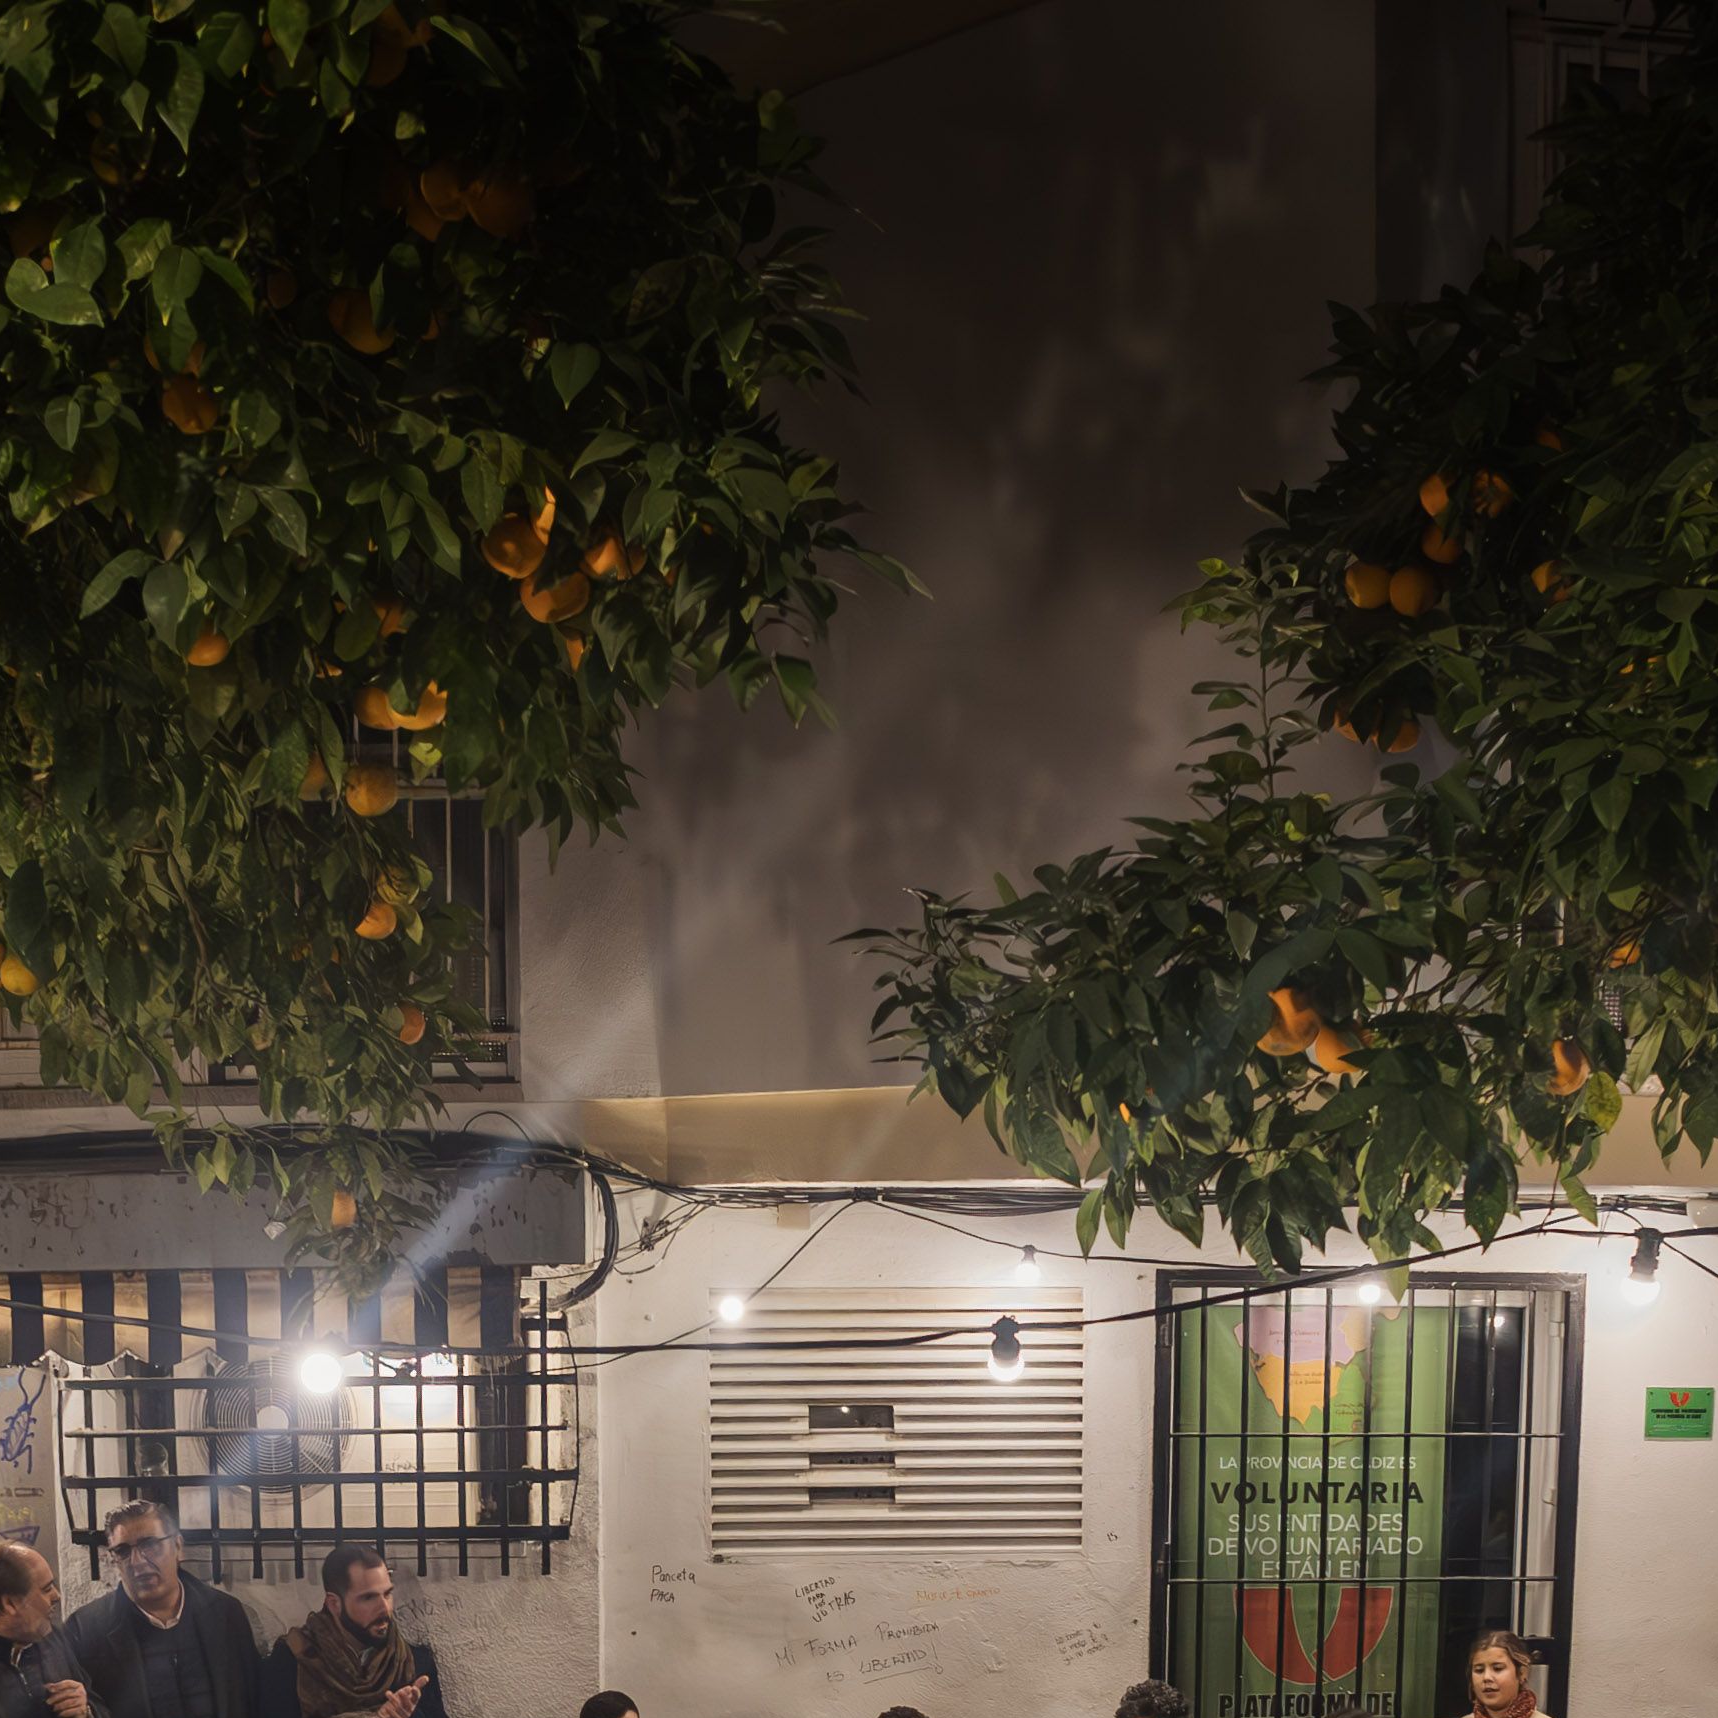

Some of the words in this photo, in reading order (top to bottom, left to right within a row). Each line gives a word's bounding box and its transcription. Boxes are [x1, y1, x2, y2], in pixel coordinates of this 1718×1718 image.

[1219, 1456, 1238, 1469] LA
[1328, 1456, 1347, 1469] DE
[1211, 1481, 1424, 1504] VOLUNTARIA
[1228, 1513, 1270, 1532] SUS
[1208, 1537, 1239, 1556] DE
[652, 1565, 696, 1584] Panceta
[1339, 1560, 1369, 1578] EN
[795, 1577, 836, 1598] LIBERTAD
[1366, 1692, 1395, 1716] DE
